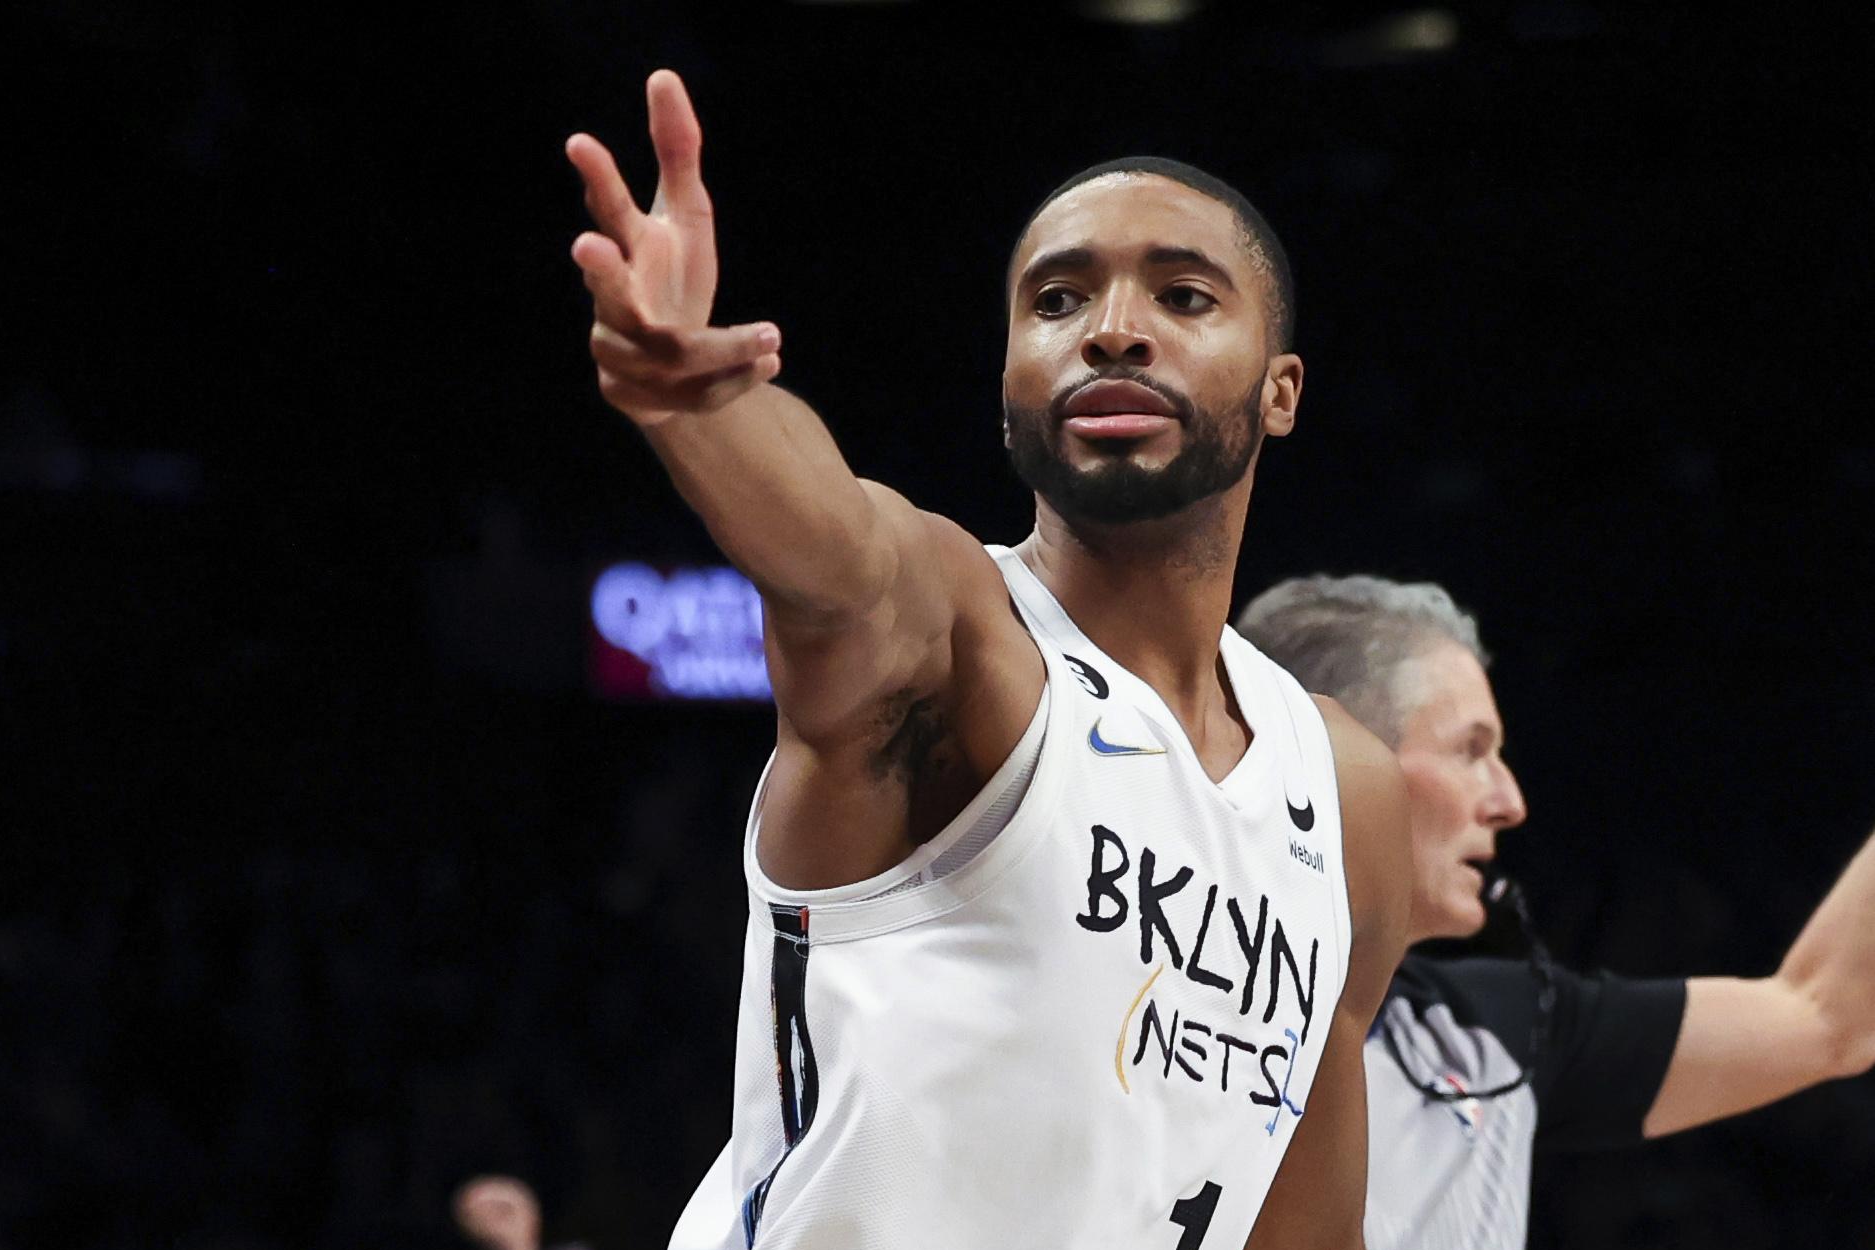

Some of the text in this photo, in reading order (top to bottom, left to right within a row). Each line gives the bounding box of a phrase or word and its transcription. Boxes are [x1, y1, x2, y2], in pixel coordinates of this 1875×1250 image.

[1288, 836, 1324, 874] Webull
[1076, 824, 1319, 1047] BKLYN
[1132, 999, 1288, 1108] NETS
